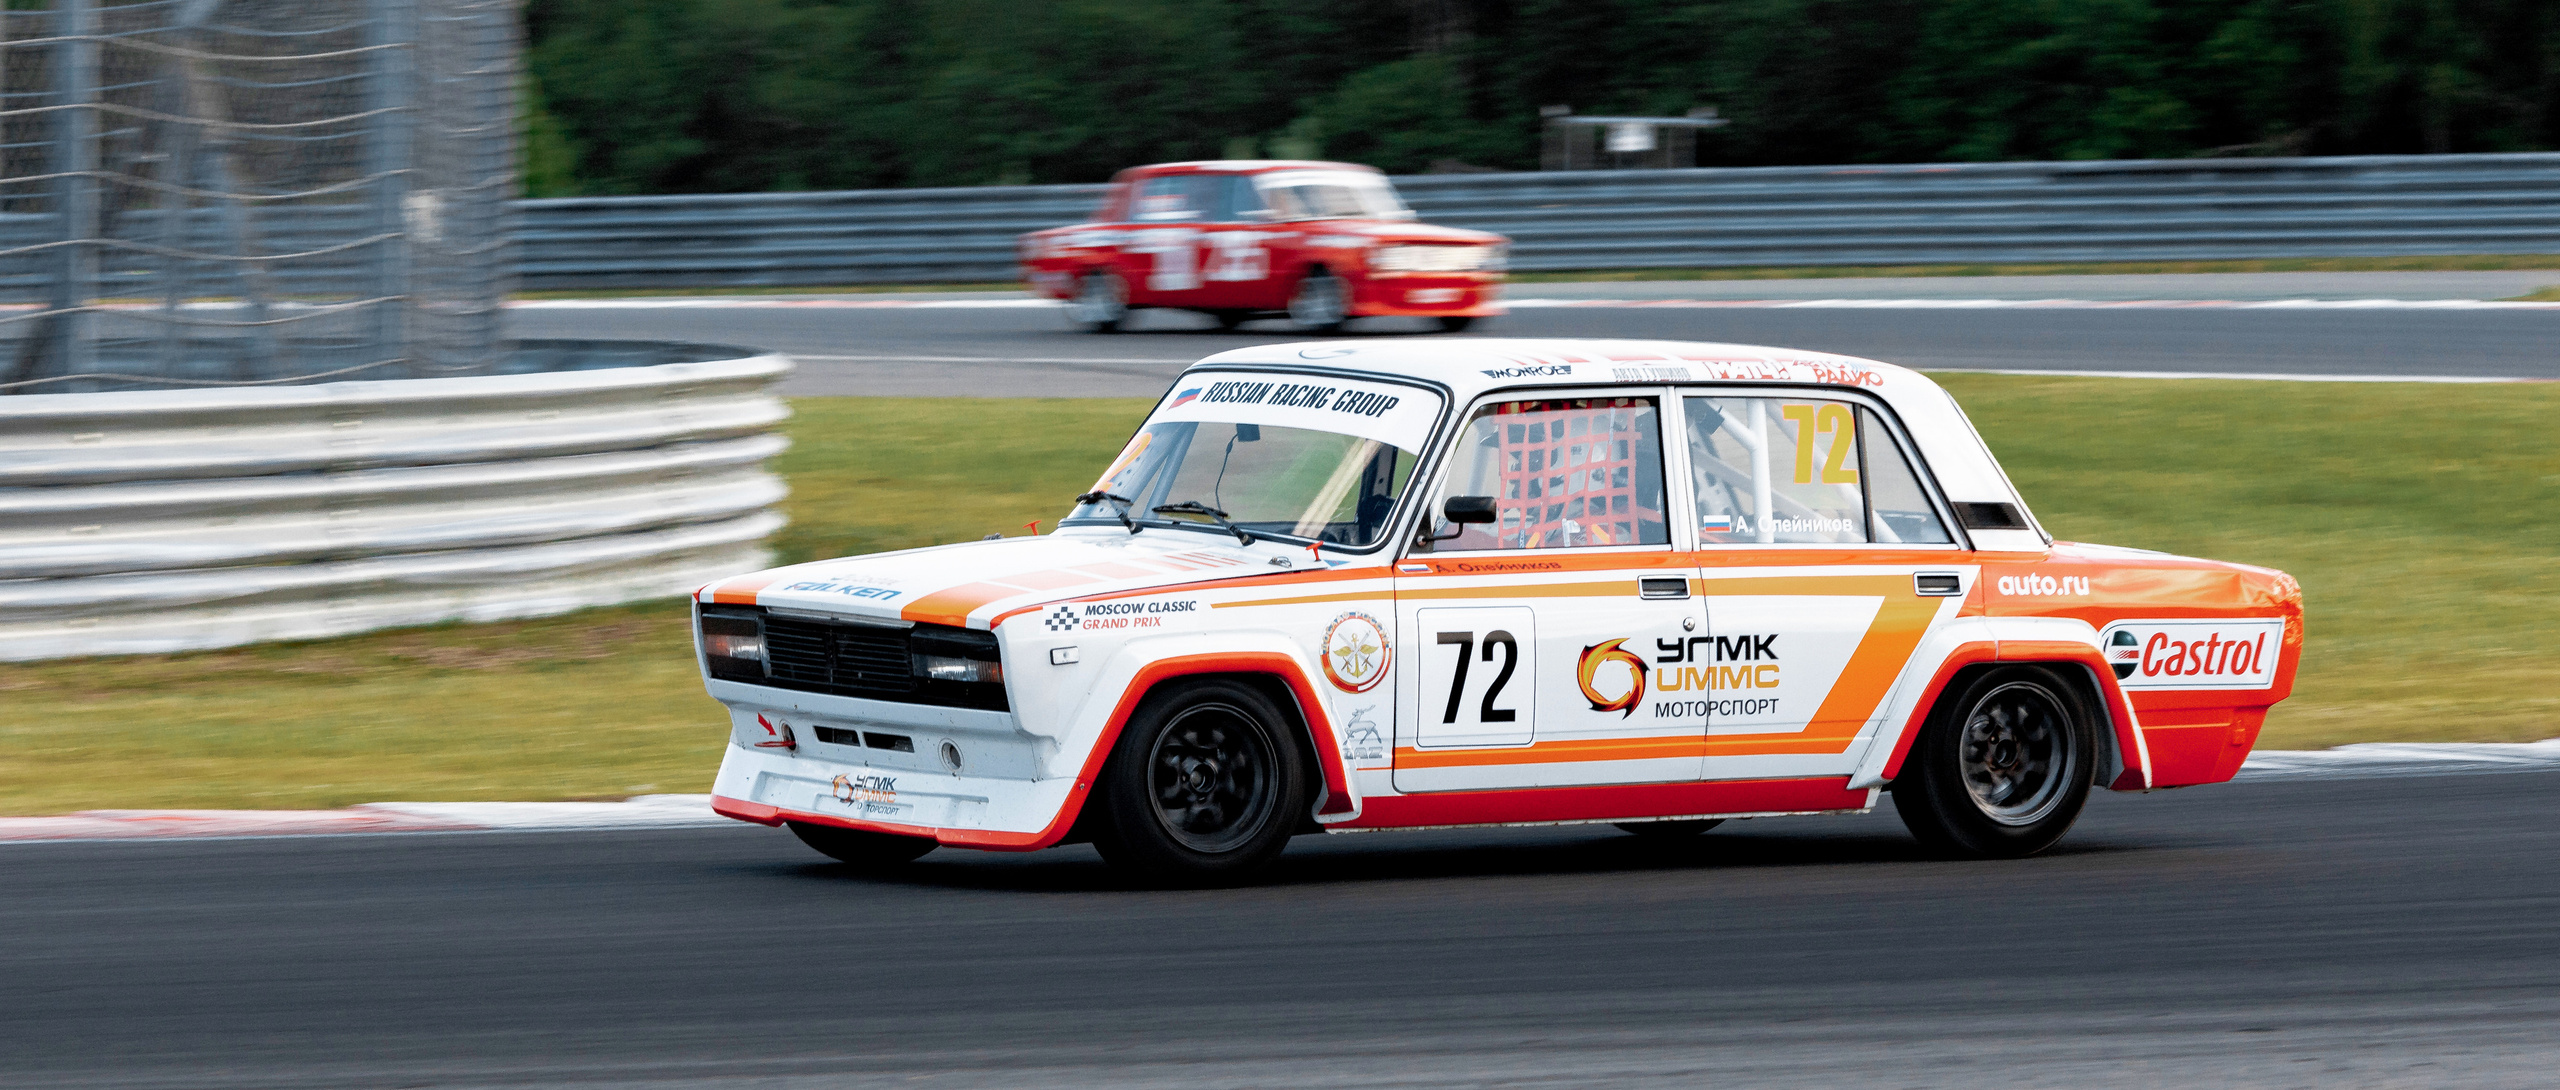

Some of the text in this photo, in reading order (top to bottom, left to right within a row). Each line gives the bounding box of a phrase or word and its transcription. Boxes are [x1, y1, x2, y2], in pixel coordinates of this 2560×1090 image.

[1201, 381, 1400, 418] RUSSIAN RACING GROUP
[1782, 403, 1859, 485] 72
[1735, 514, 1854, 534] А. Олейников
[1458, 560, 1562, 573] Олейников
[1998, 572, 2090, 596] auto.ru
[1085, 600, 1197, 616] MOSCOW CLASSIC
[1082, 616, 1162, 630] GRAND PRIX
[1656, 633, 1780, 664] УГМК
[2142, 630, 2267, 678] Castrol
[1437, 630, 1518, 725] 72
[1656, 664, 1780, 692] UMMC
[1655, 698, 1780, 719] МОТОРСПОРТ
